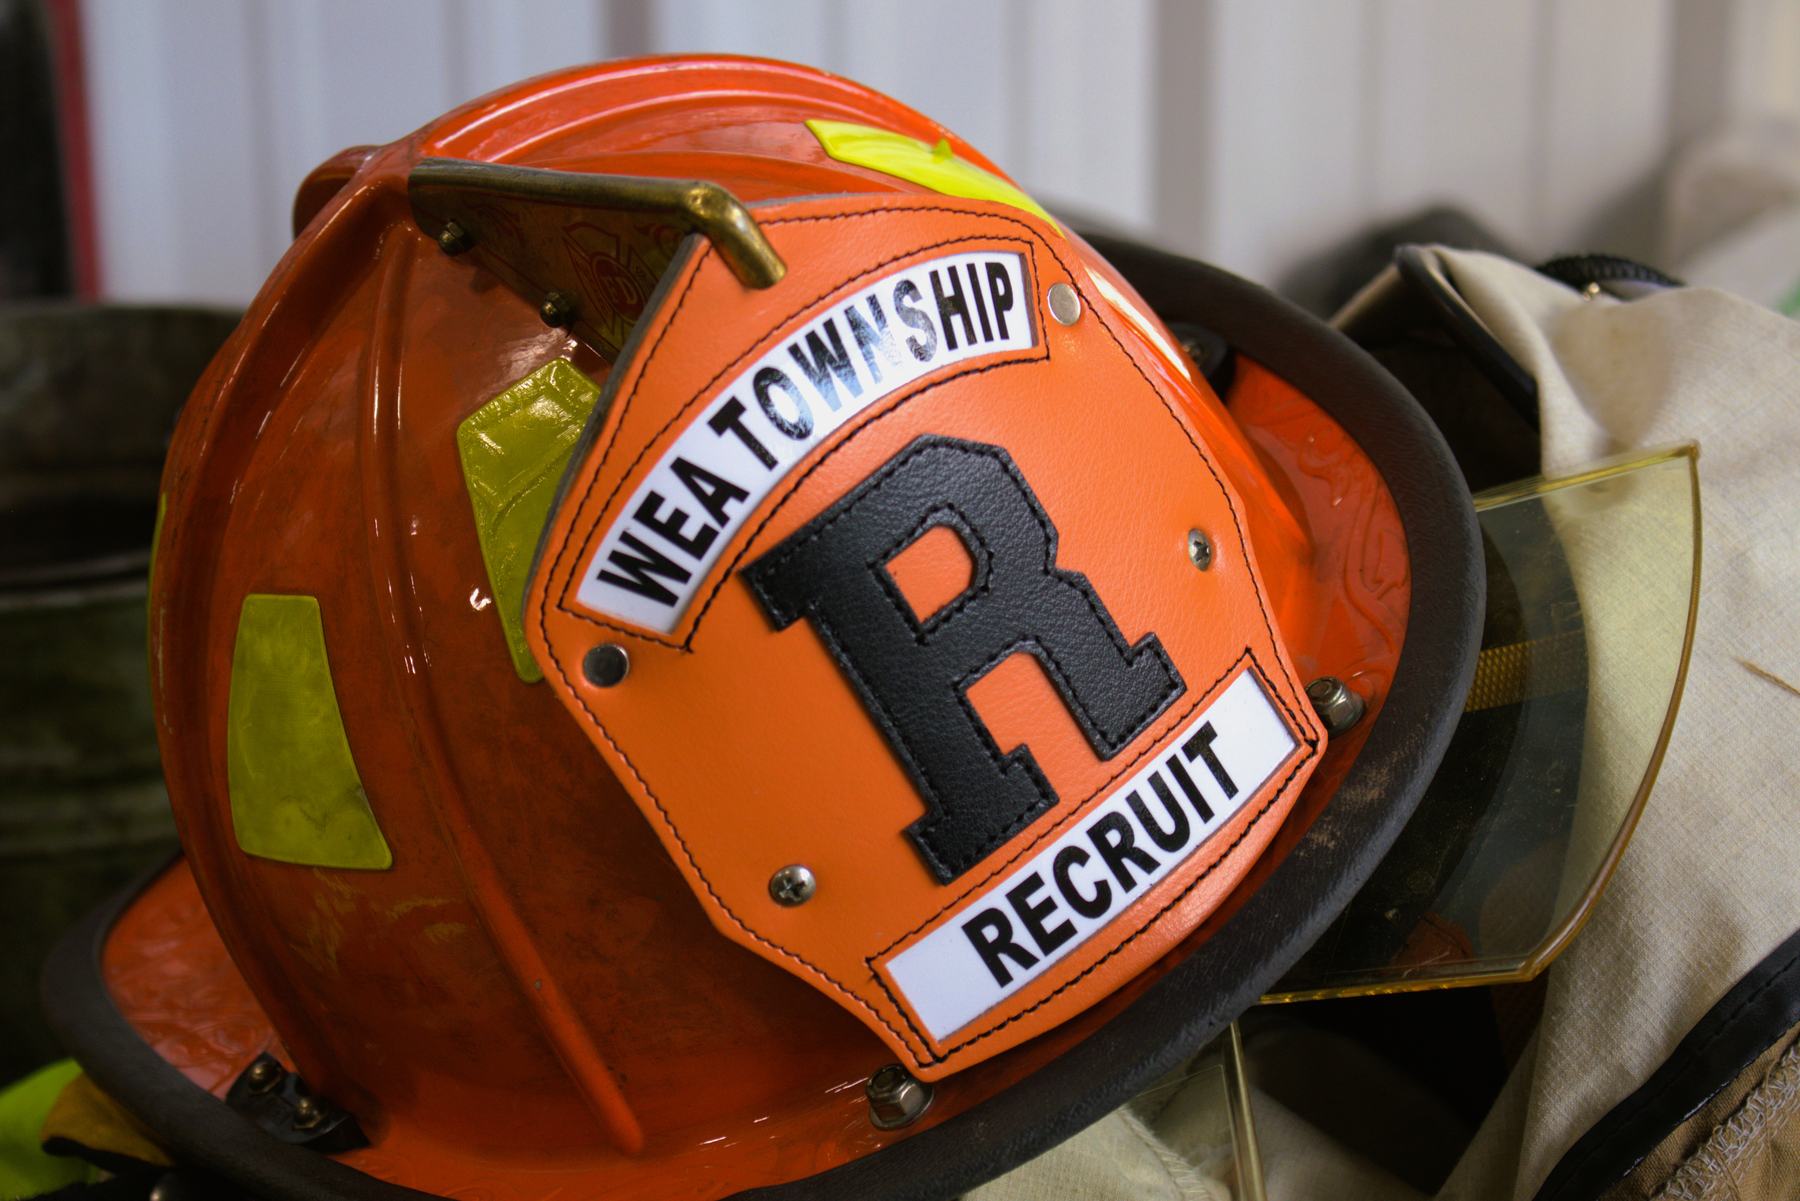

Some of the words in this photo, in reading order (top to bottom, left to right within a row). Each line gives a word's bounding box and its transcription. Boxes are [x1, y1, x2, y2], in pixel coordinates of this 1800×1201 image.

[596, 456, 751, 608] WEA
[707, 261, 1015, 472] TOWNSHIP
[738, 433, 1188, 887] R
[961, 720, 1240, 989] RECRUIT
